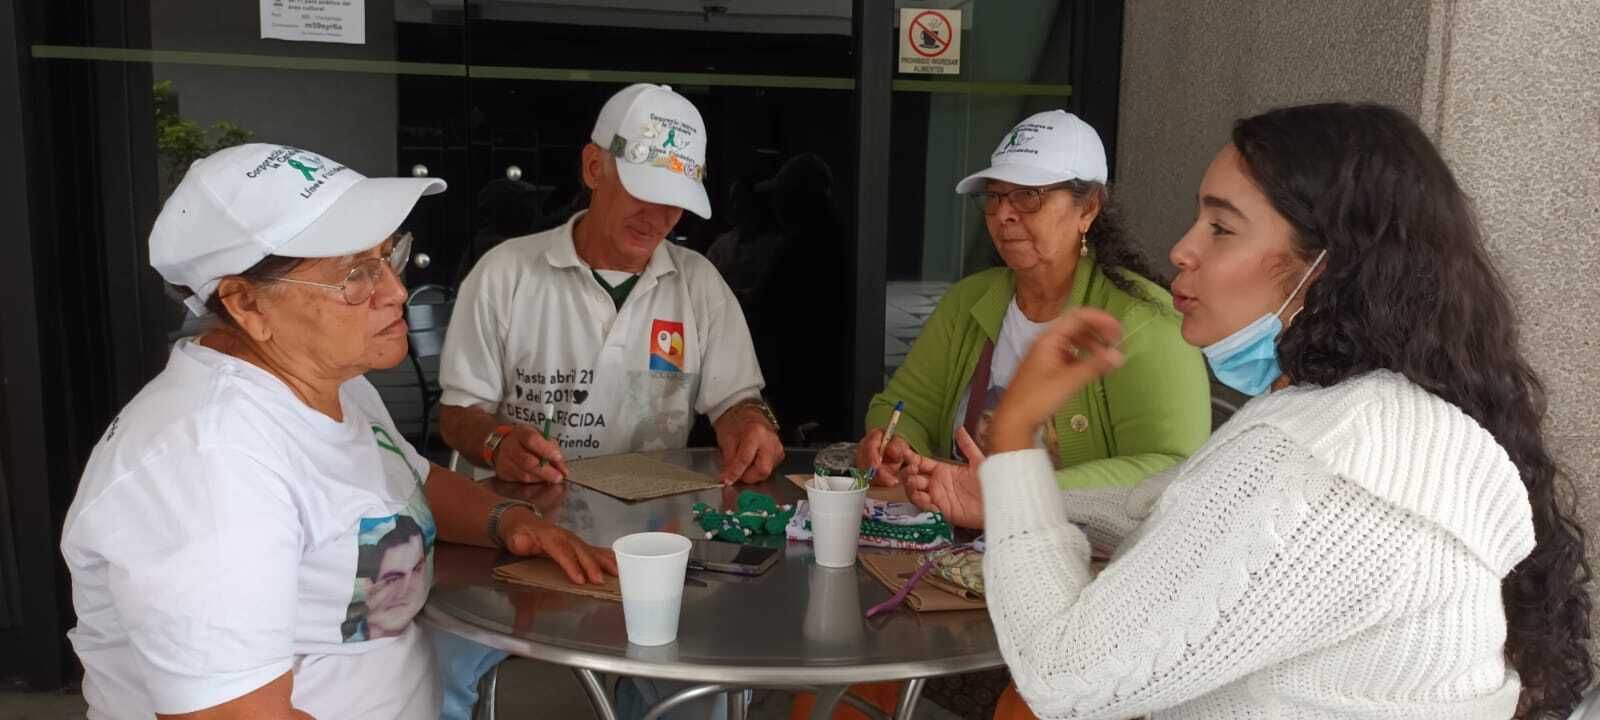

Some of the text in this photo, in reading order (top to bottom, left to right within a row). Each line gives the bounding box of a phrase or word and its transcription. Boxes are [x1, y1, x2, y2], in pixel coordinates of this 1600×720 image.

[516, 367, 595, 385] Hasta abril 21
[526, 388, 542, 404] del
